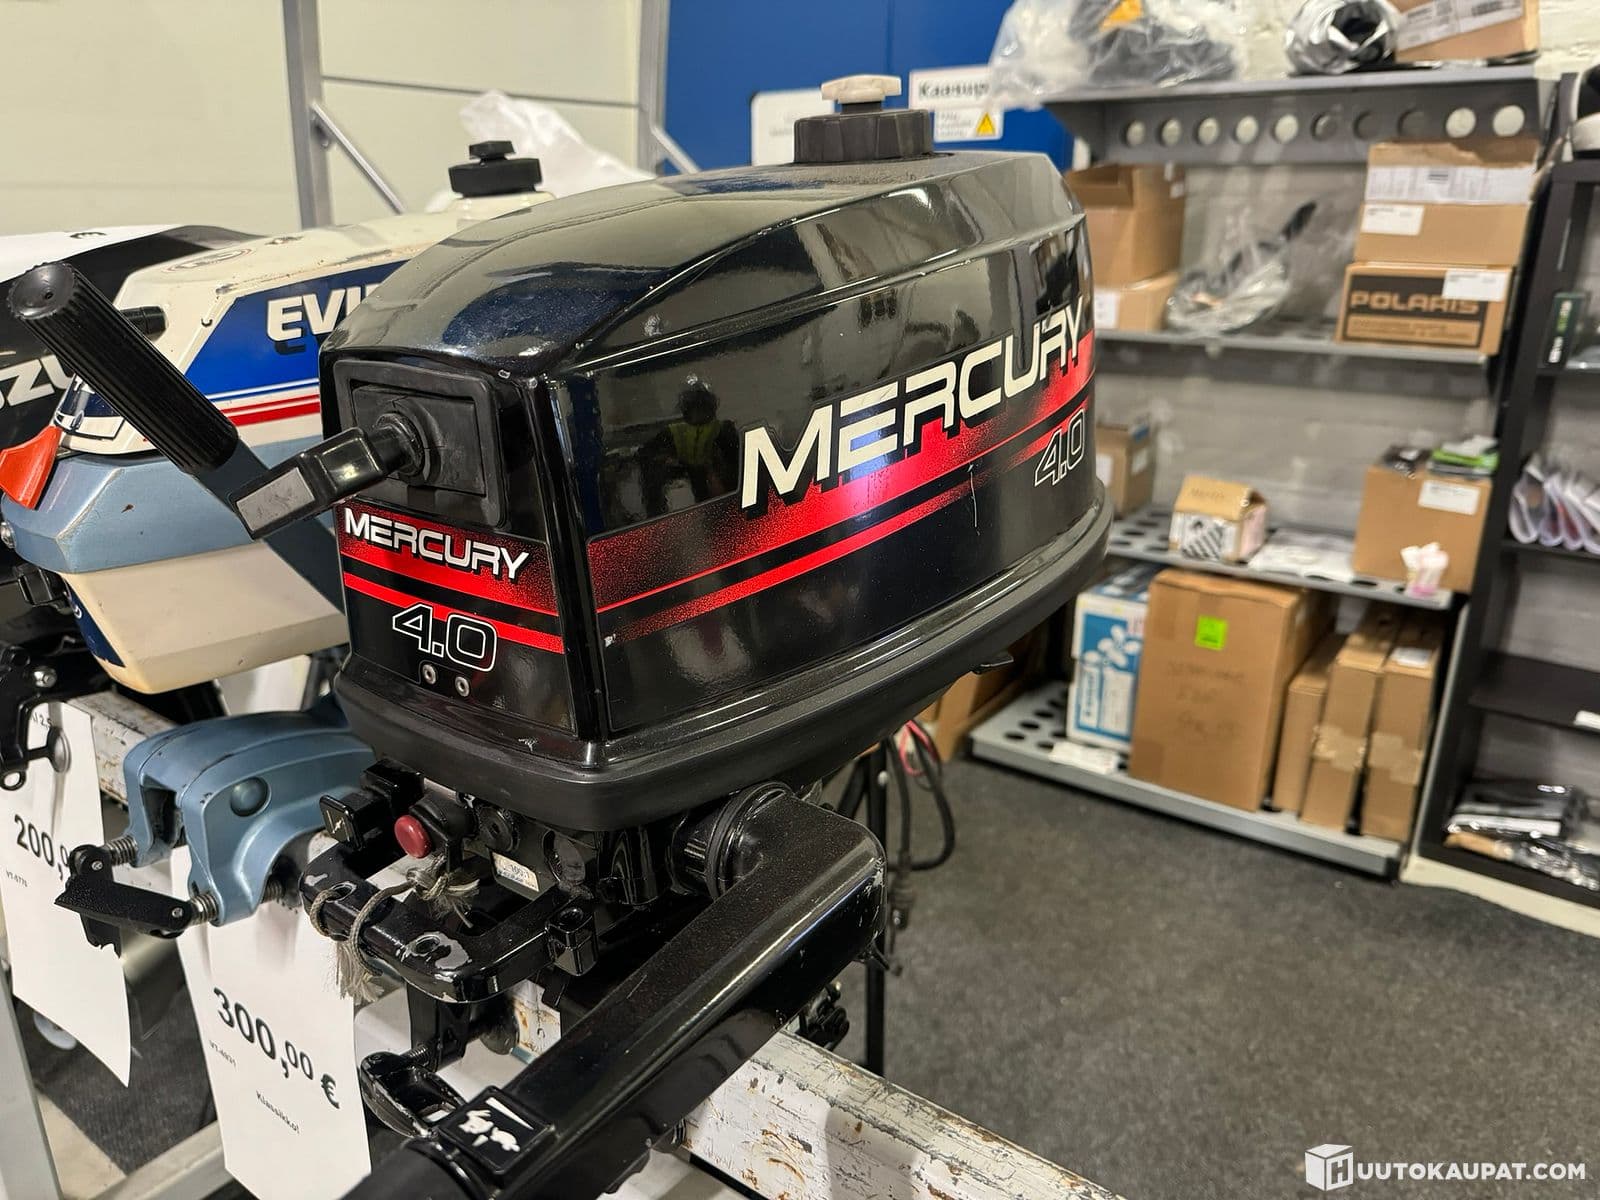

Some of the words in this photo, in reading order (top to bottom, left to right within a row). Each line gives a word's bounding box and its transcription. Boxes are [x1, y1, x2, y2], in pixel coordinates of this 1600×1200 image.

[267, 282, 383, 342] EVI
[1351, 290, 1480, 315] POLARIS
[742, 295, 1084, 509] MERCURY
[1033, 408, 1086, 488] 4.0
[344, 507, 530, 580] MERCURY
[392, 602, 498, 672] 4.0
[14, 814, 70, 881] 200,0
[213, 987, 314, 1080] 300,00
[320, 1073, 341, 1110] €
